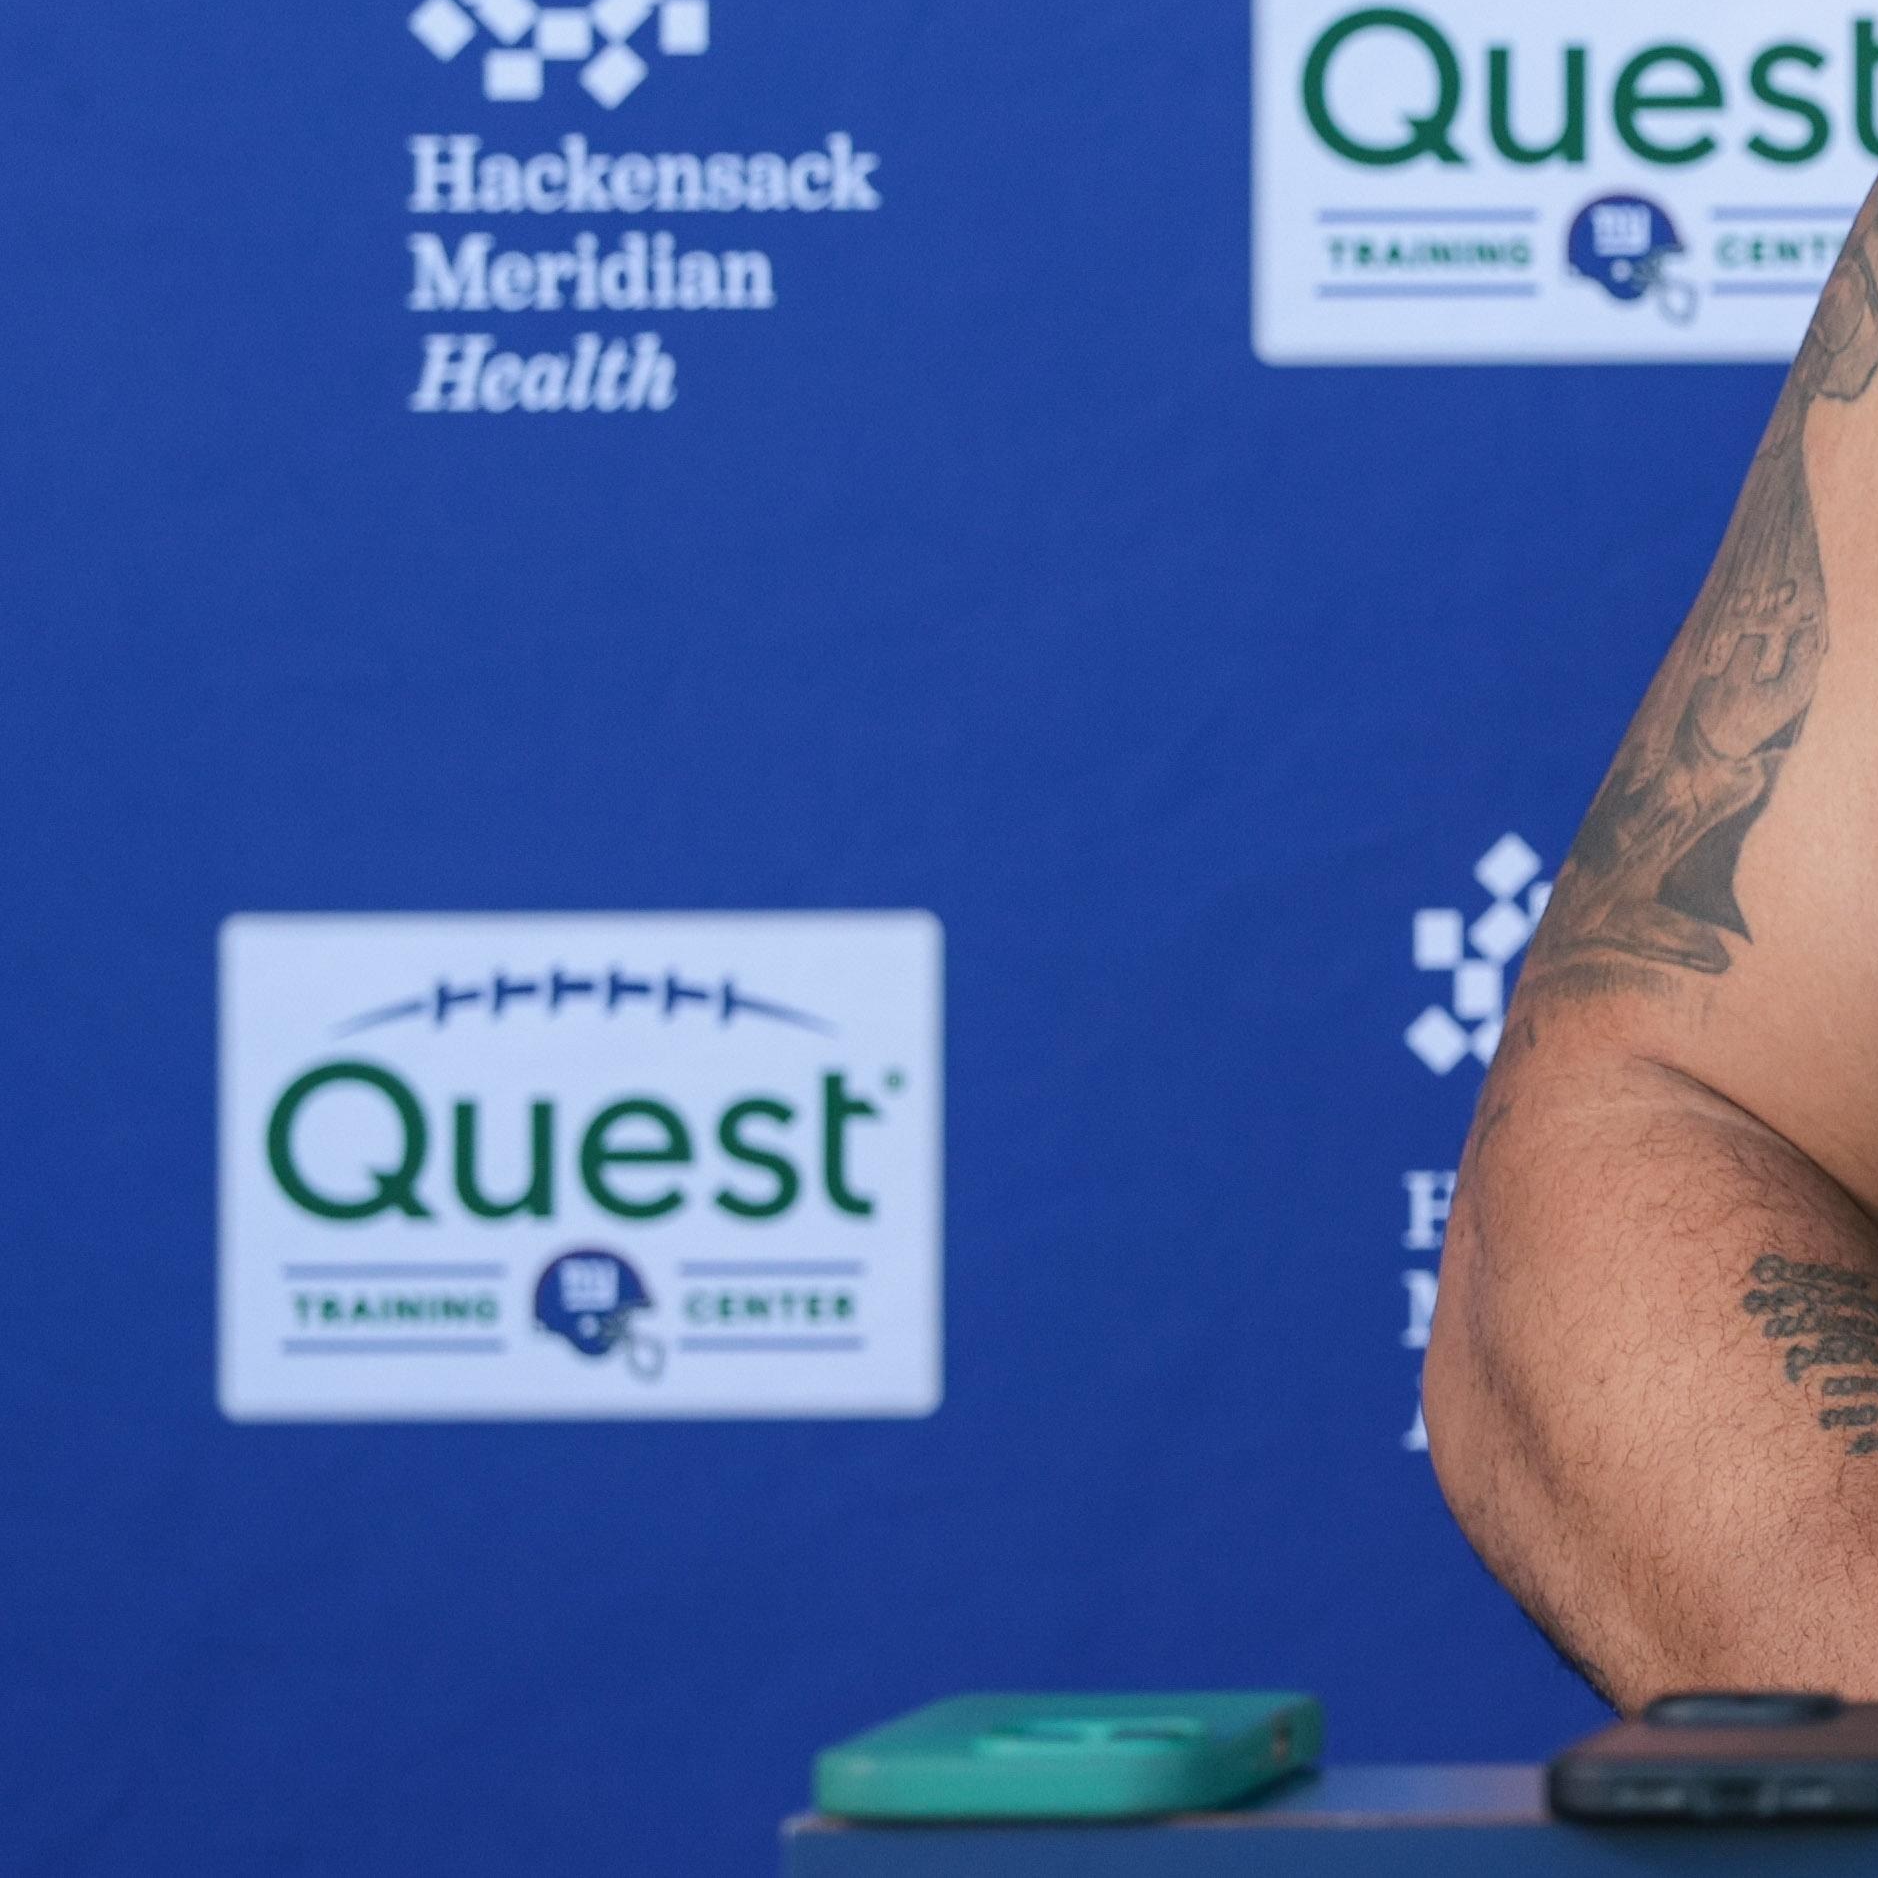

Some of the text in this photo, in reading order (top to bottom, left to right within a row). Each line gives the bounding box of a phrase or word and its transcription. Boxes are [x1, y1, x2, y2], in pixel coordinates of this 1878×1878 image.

[409, 132, 880, 213] Hackensack
[409, 231, 775, 311] Meridian
[1328, 234, 1845, 270] TRAINING CENT
[411, 333, 676, 412] Health
[264, 1058, 880, 1222] Quest
[294, 1289, 856, 1326] TRAINING CENTER
